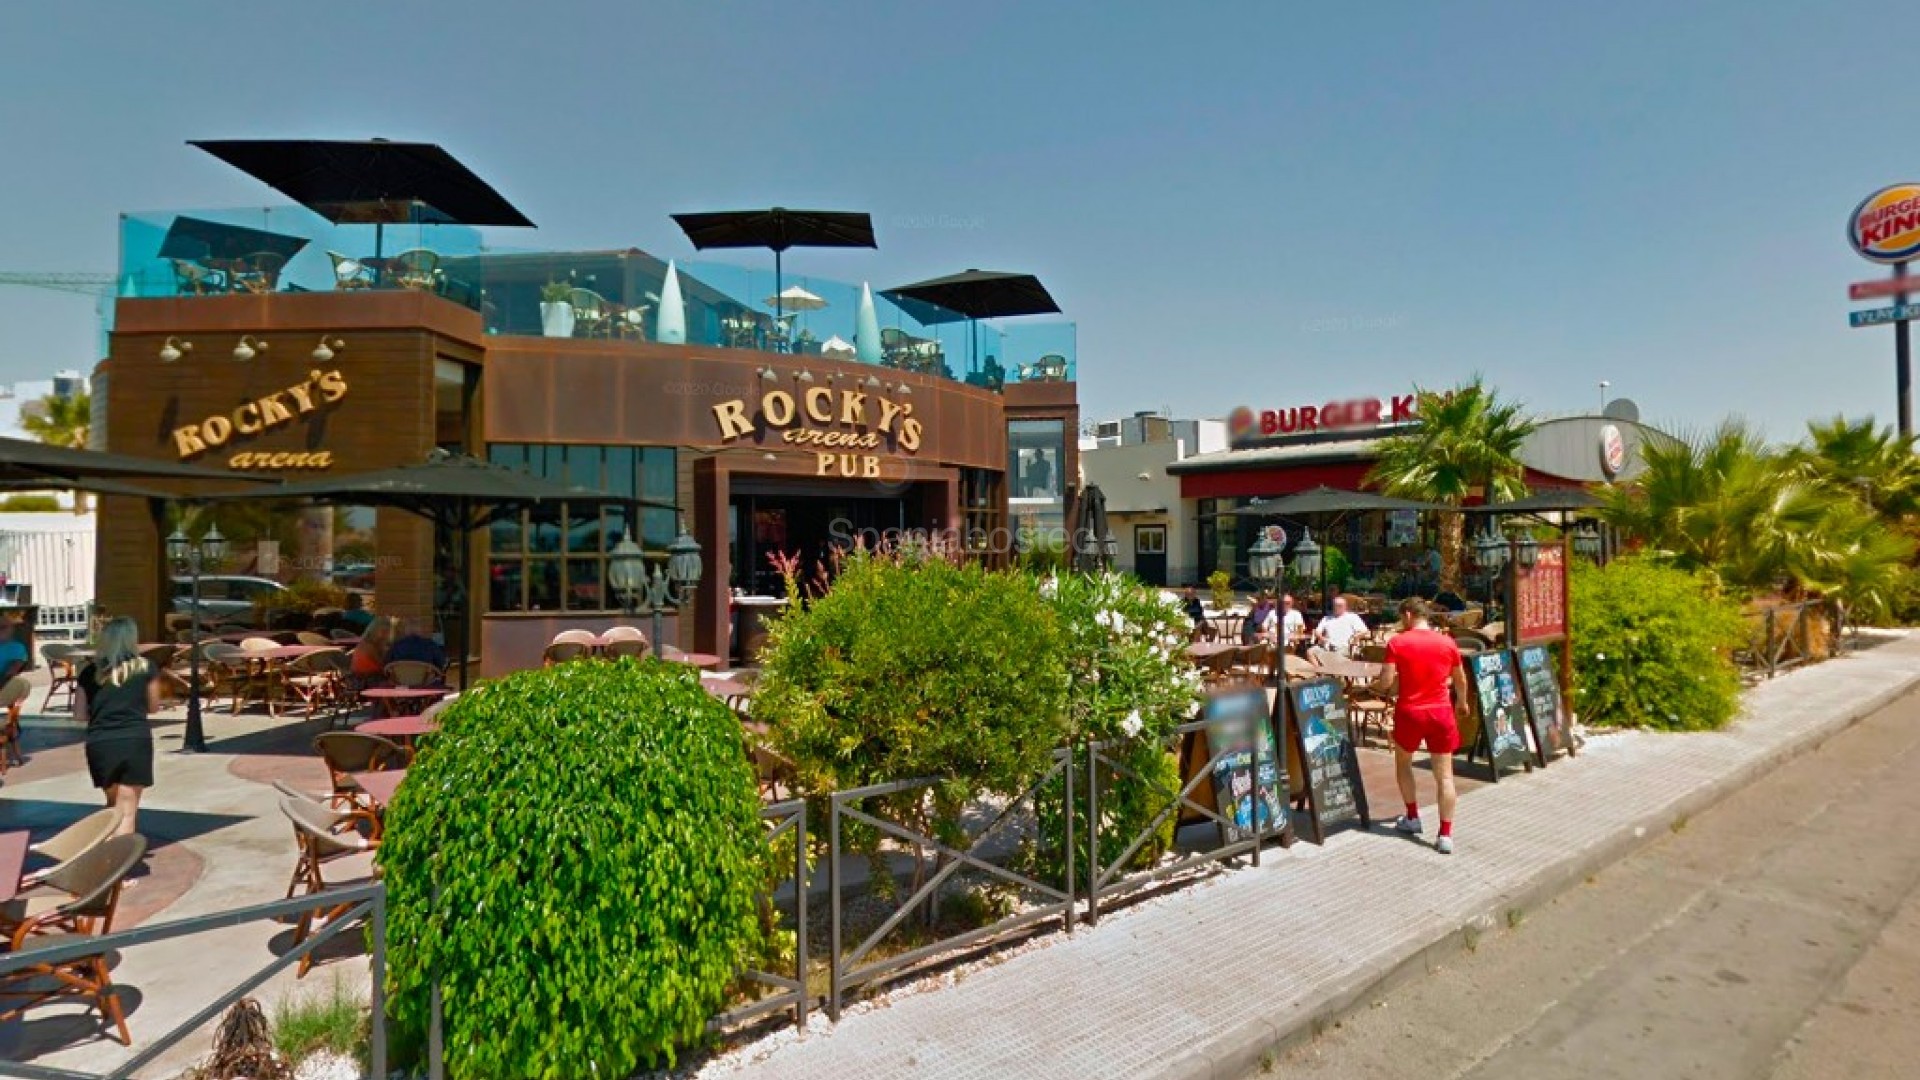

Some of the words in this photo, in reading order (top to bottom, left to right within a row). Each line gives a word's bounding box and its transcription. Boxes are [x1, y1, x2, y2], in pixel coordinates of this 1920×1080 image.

[1862, 211, 1920, 248] KIN
[173, 369, 347, 457] ROCKY'S
[712, 387, 922, 451] ROCKY'S
[781, 426, 880, 448] arena
[228, 451, 334, 469] arena
[816, 452, 880, 478] PUB
